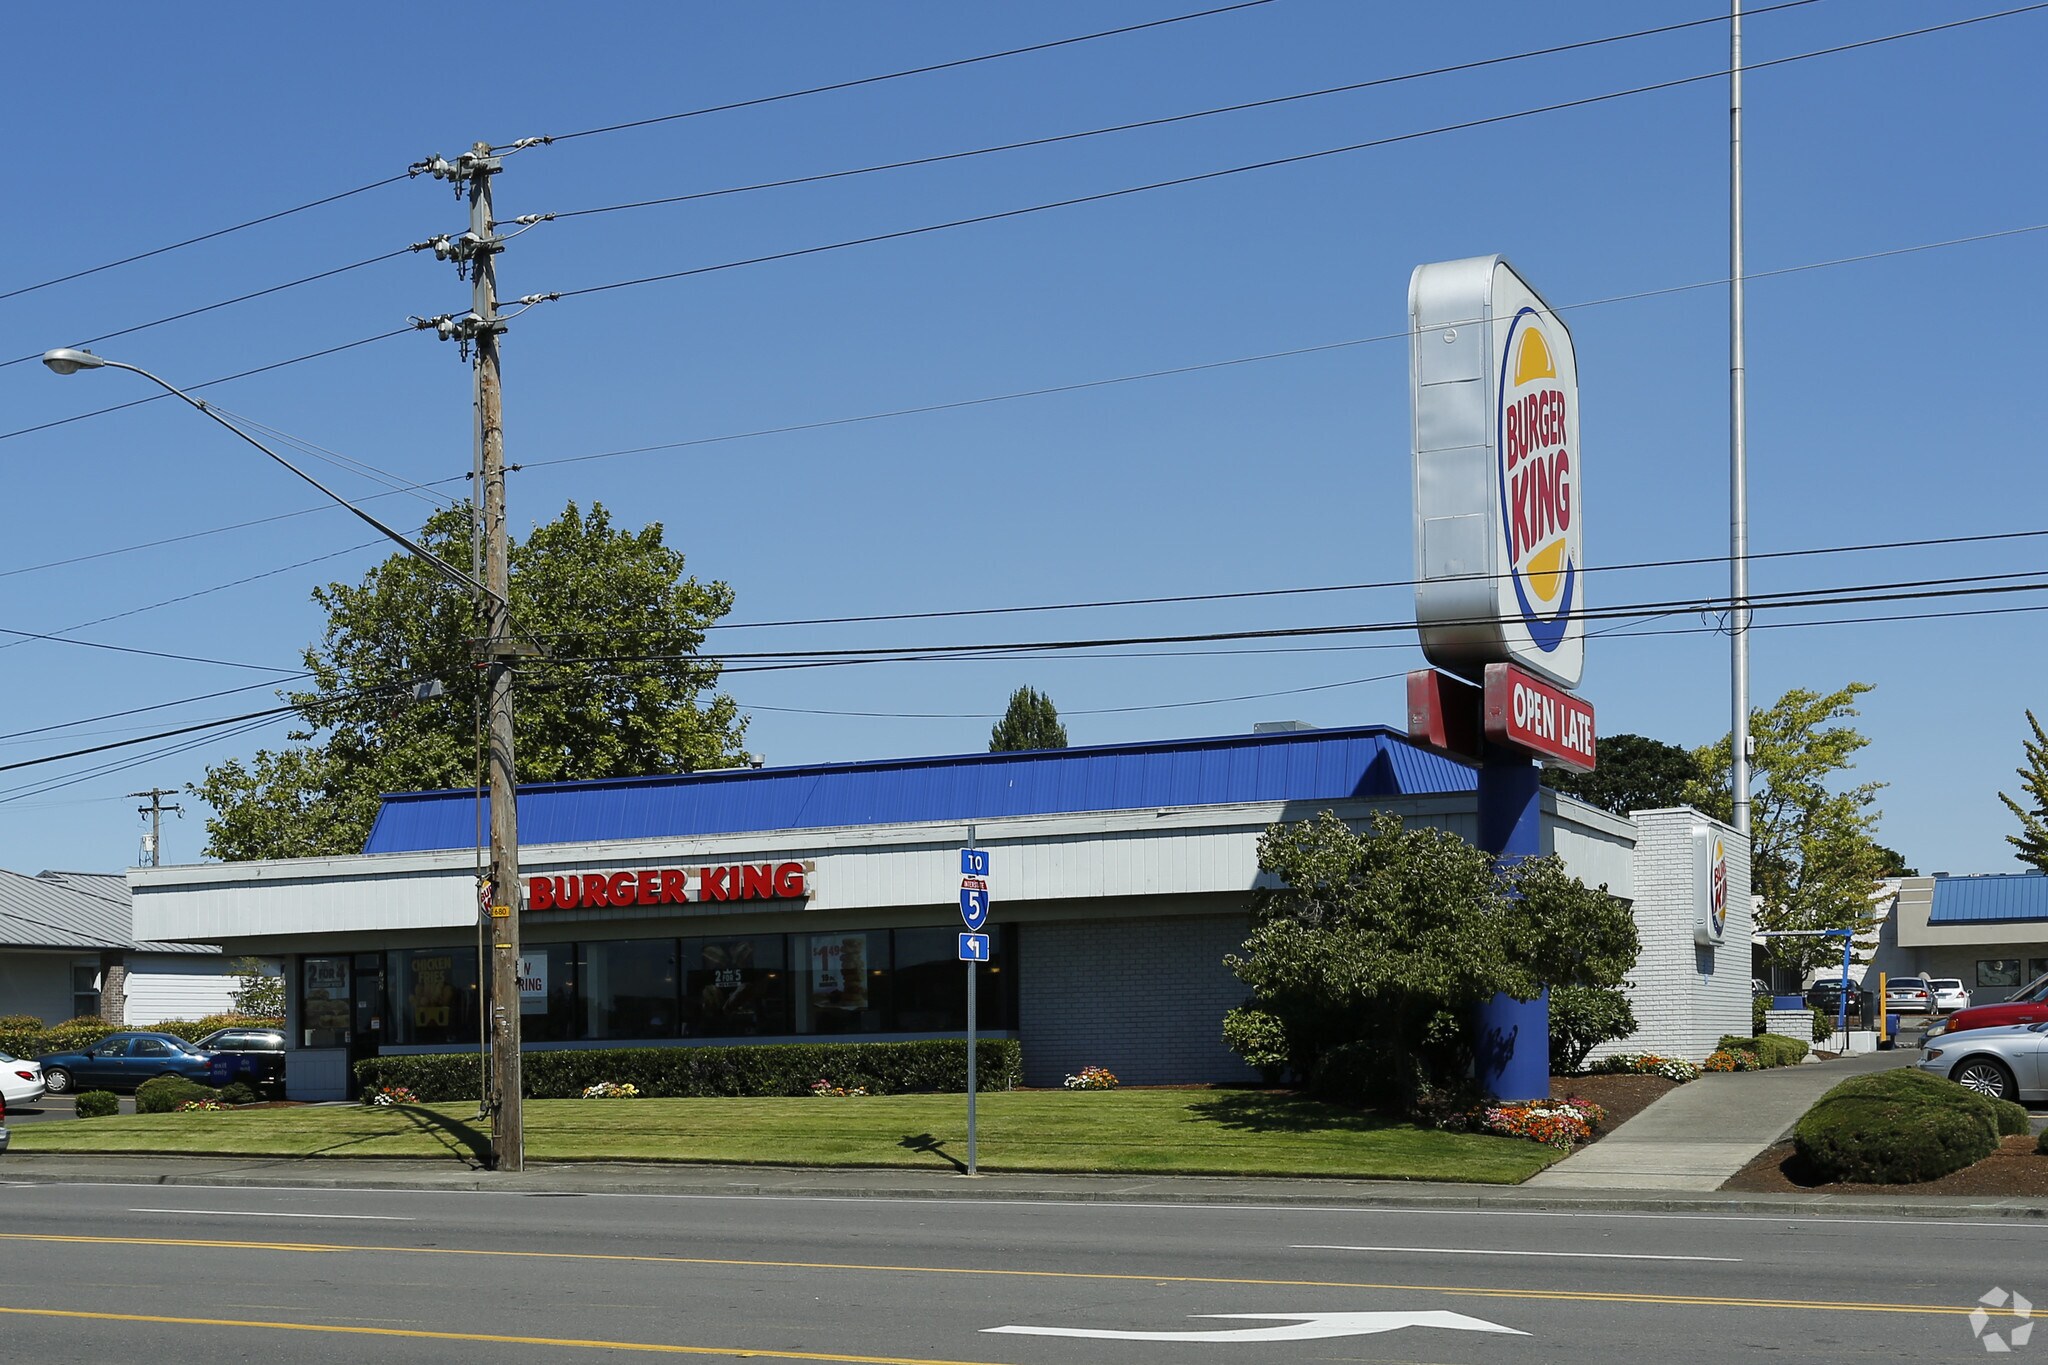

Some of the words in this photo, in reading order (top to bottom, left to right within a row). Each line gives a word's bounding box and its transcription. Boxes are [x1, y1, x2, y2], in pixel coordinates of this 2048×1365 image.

[1507, 389, 1567, 472] BURGER
[1511, 448, 1571, 566] KING
[1513, 682, 1555, 741] OPEN
[1560, 704, 1592, 756] LATE
[967, 854, 983, 870] TO
[529, 868, 690, 911] BURGER
[700, 861, 805, 901] KING
[968, 891, 981, 920] 5
[411, 956, 452, 972] CHICKEN
[308, 965, 317, 980] 2
[319, 967, 335, 979] FOR
[419, 971, 446, 984] FRIES
[715, 969, 722, 982] 2
[722, 974, 734, 982] FOR
[735, 968, 742, 981] 5
[519, 978, 542, 991] RING
[213, 1061, 227, 1069] exit
[240, 1058, 250, 1066] do
